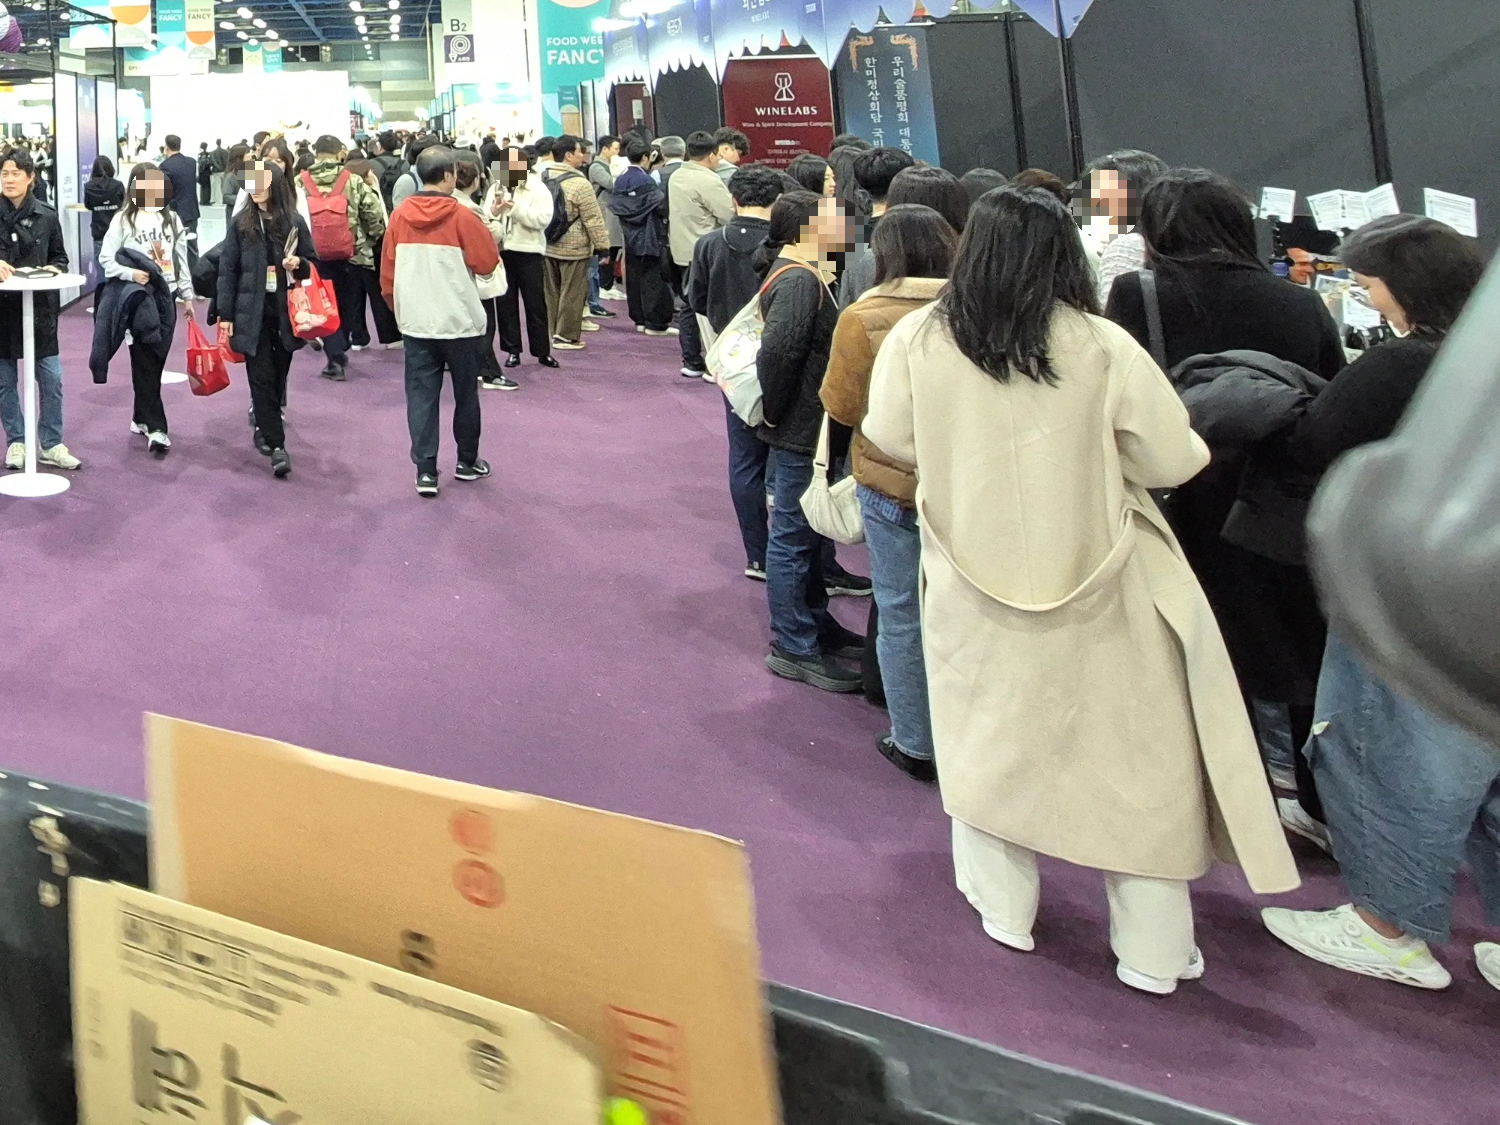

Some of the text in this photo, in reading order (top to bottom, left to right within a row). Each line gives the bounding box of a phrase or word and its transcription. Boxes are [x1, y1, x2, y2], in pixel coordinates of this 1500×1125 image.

[160, 14, 182, 22] FANCY
[450, 18, 467, 32] B2
[546, 36, 578, 46] FOOD
[580, 35, 603, 45] WEE
[864, 56, 884, 123] 한미정상회담
[755, 106, 818, 116] WINELABS
[891, 56, 913, 156] 우리술품평회 대통
